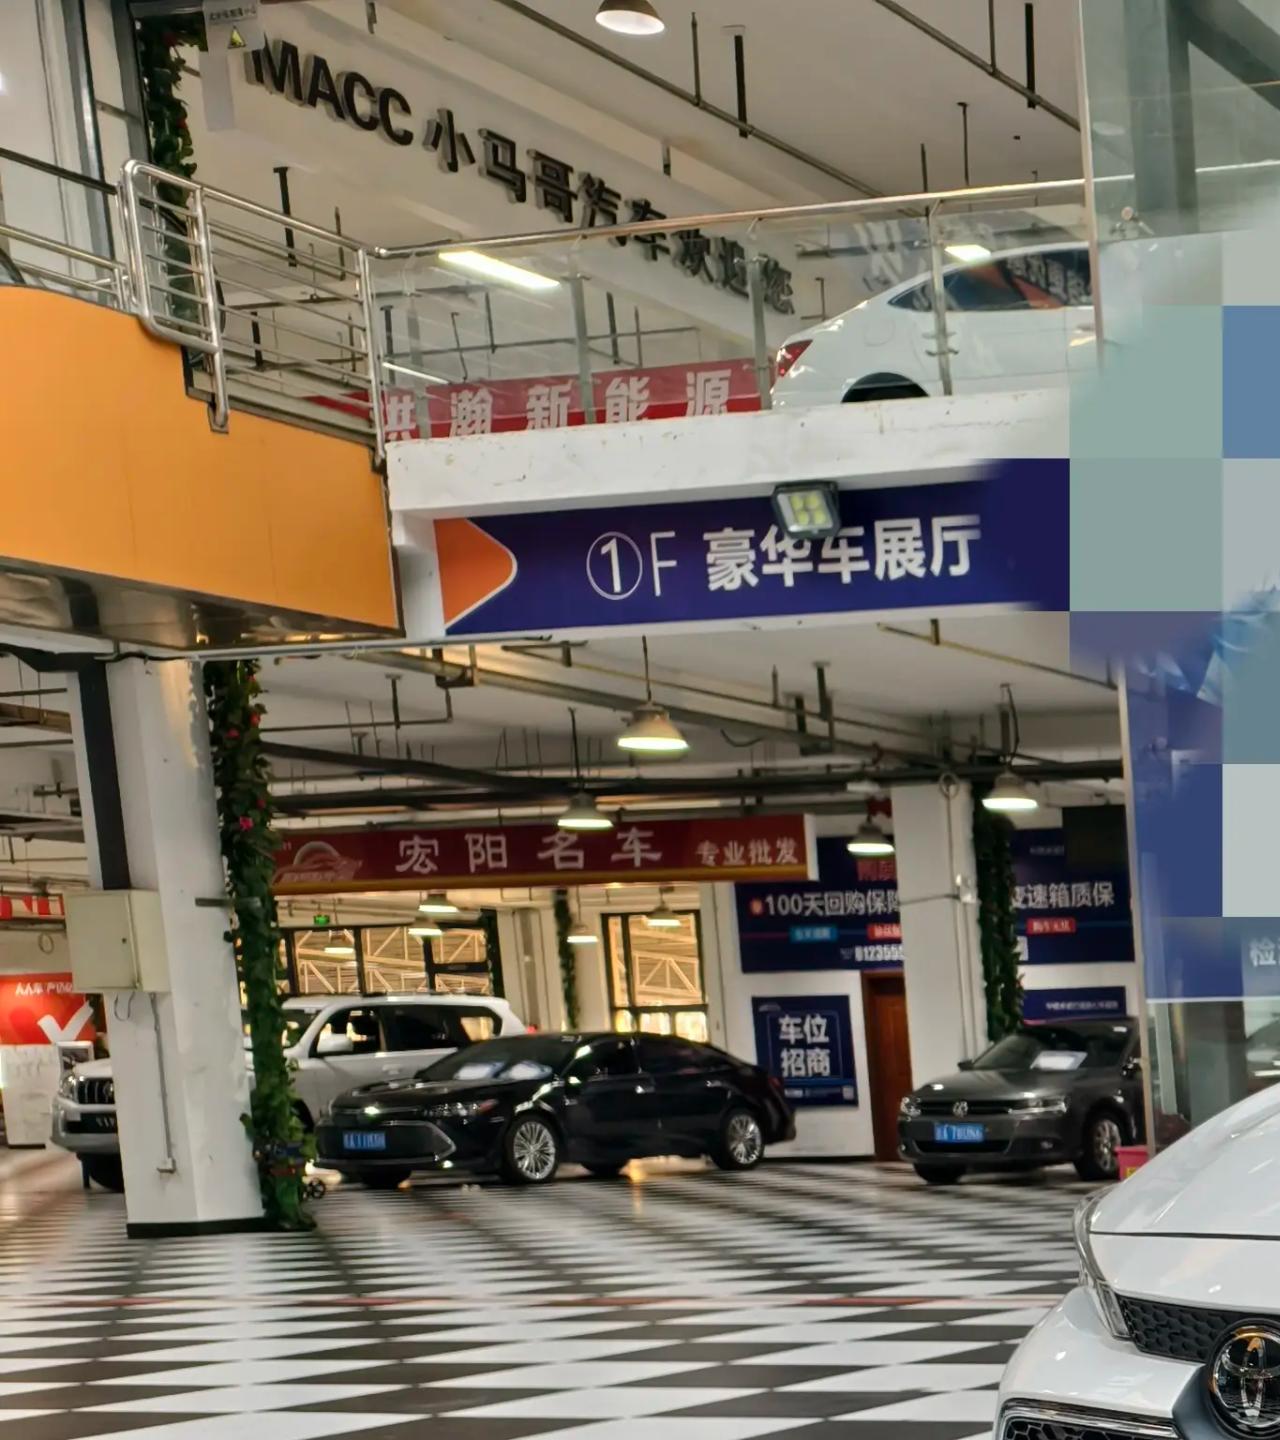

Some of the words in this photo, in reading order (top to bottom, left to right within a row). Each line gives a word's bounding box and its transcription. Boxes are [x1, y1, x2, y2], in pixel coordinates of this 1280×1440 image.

[245, 36, 415, 146] MACC
[702, 515, 982, 591] 豪华车展厅
[395, 827, 662, 874] 宏阳名车
[695, 836, 799, 868] 专业批发
[779, 1013, 830, 1045] 车位
[780, 1047, 831, 1078] 招商
